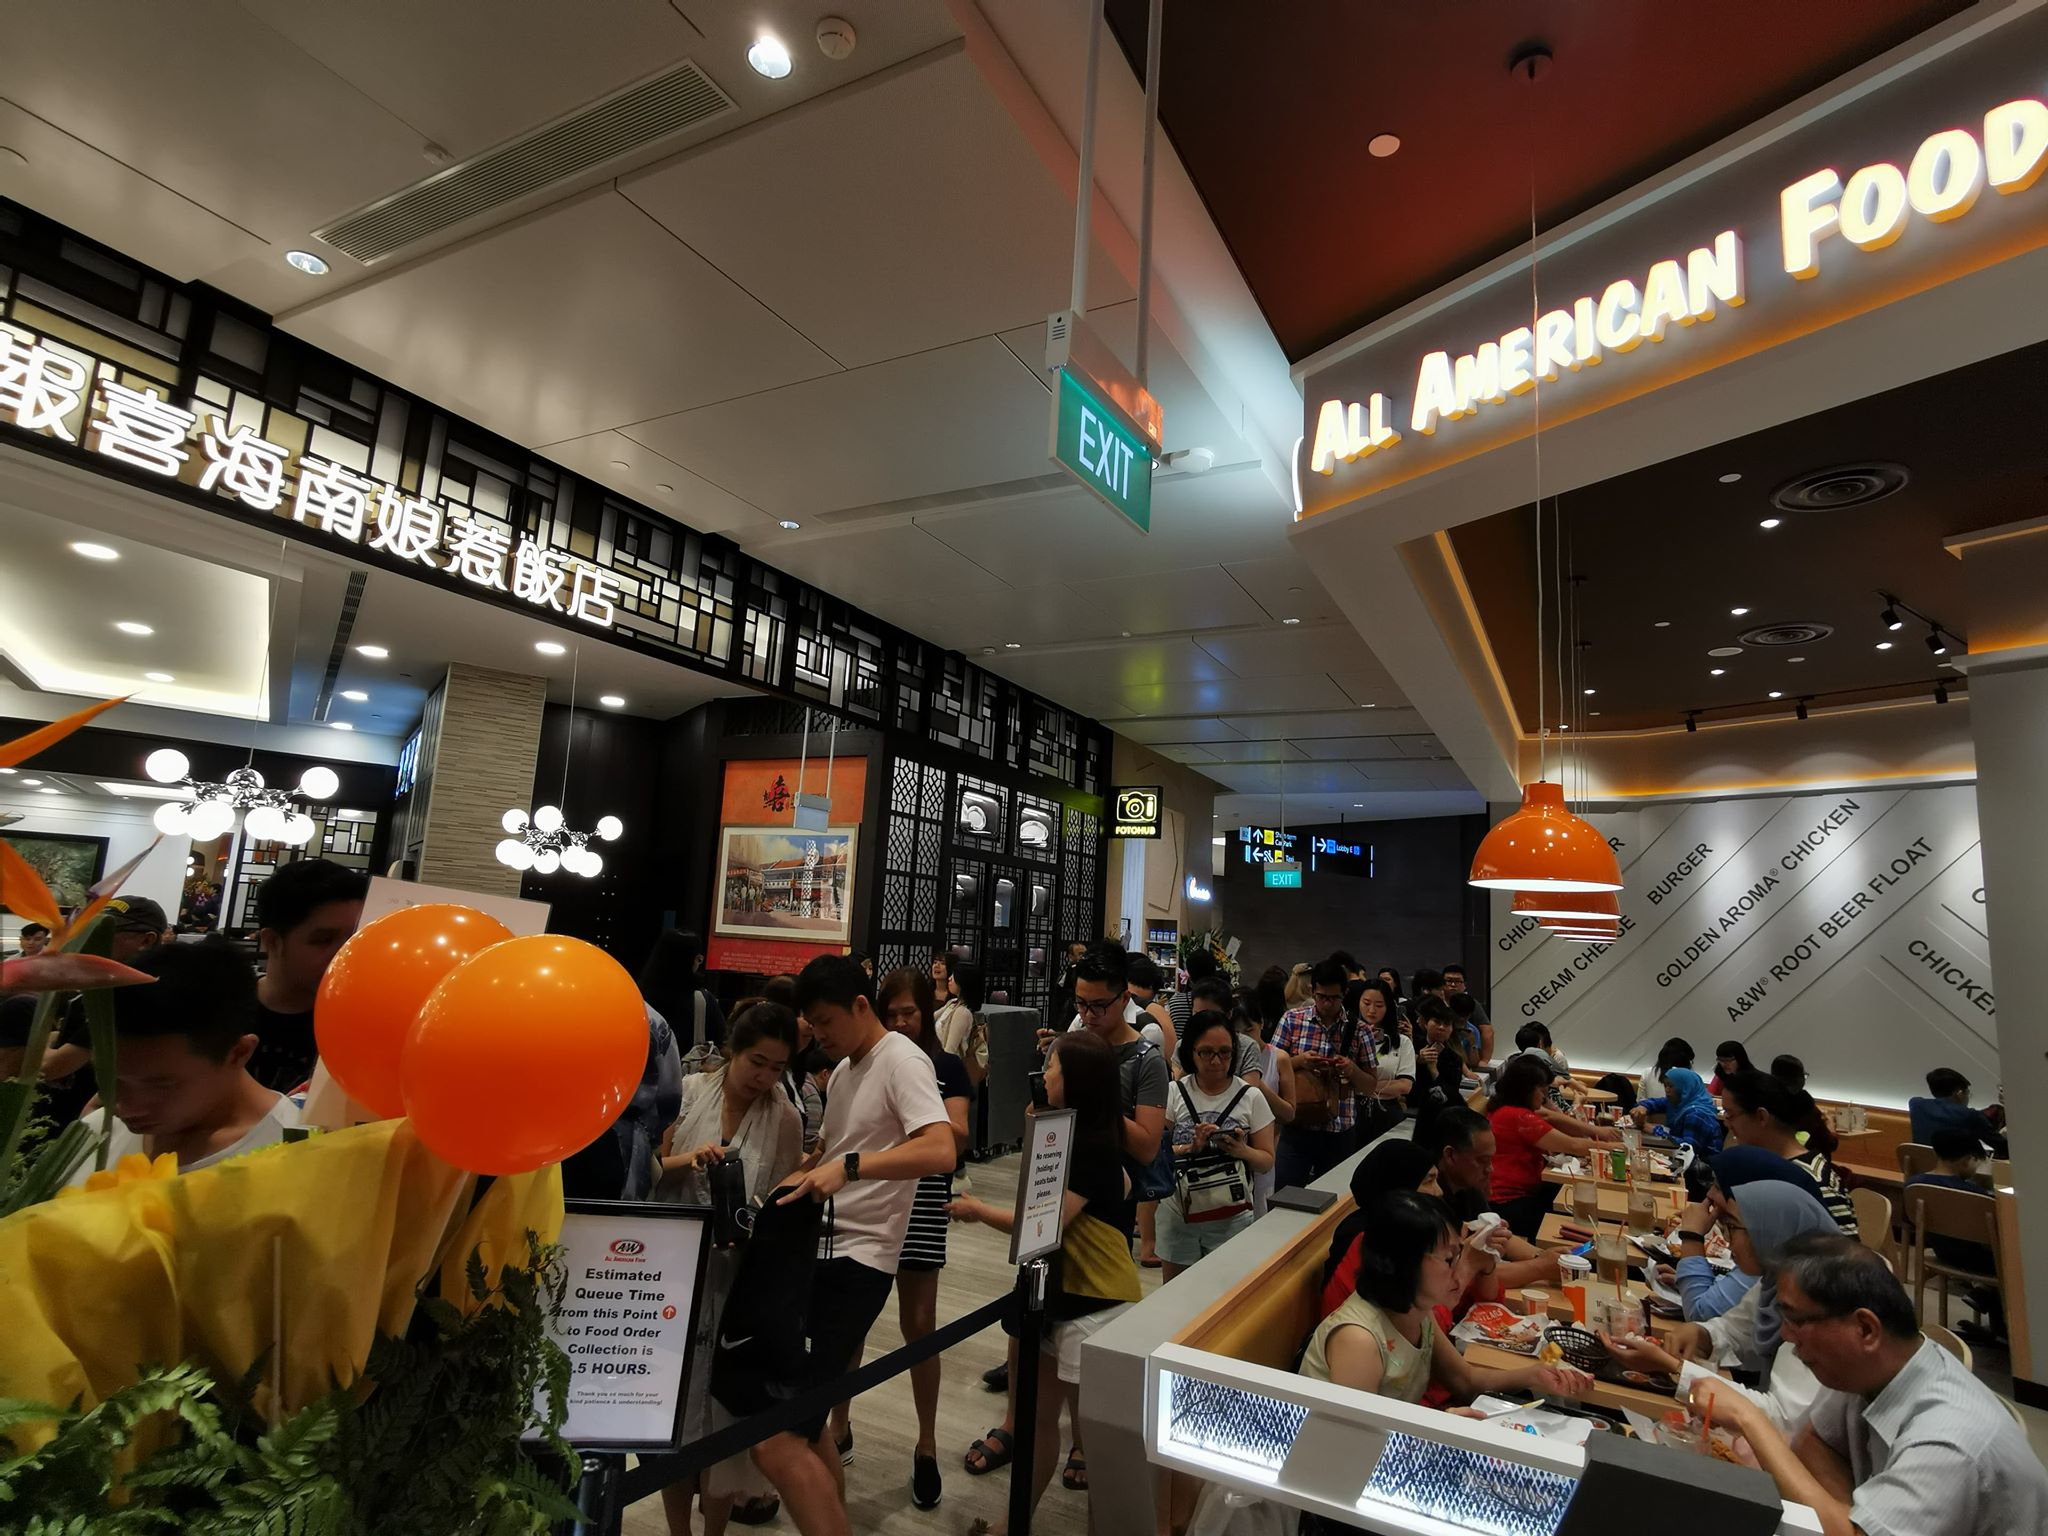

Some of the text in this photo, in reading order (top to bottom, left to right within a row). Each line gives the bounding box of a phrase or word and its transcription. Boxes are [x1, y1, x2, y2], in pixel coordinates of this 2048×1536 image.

[1311, 99, 2048, 475] ALL AMERICAN FOOD
[1078, 405, 1134, 500] EXIT
[1115, 826, 1156, 835] FOTOHUB
[1275, 831, 1297, 840] Shrt-term
[1272, 873, 1293, 885] EXIT
[1656, 927, 1721, 988] GOLDEN
[1781, 798, 1860, 871] CHICKEN
[1768, 934, 1822, 982] ROOT
[1818, 891, 1874, 939] BEER
[1867, 836, 1934, 895] FLOAT
[1498, 916, 1540, 951] CHIC
[1521, 842, 1714, 1018] CREAM CHEE BURGER
[1908, 940, 1996, 1016] CHICKE
[585, 1268, 662, 1282] Estimated
[575, 1288, 665, 1301] Queue Time
[593, 1308, 619, 1319] this
[623, 1309, 659, 1320] Point
[567, 1325, 661, 1338] to Food Order
[568, 1344, 654, 1356] Collection is
[572, 1363, 651, 1375] .5 HOURS.
